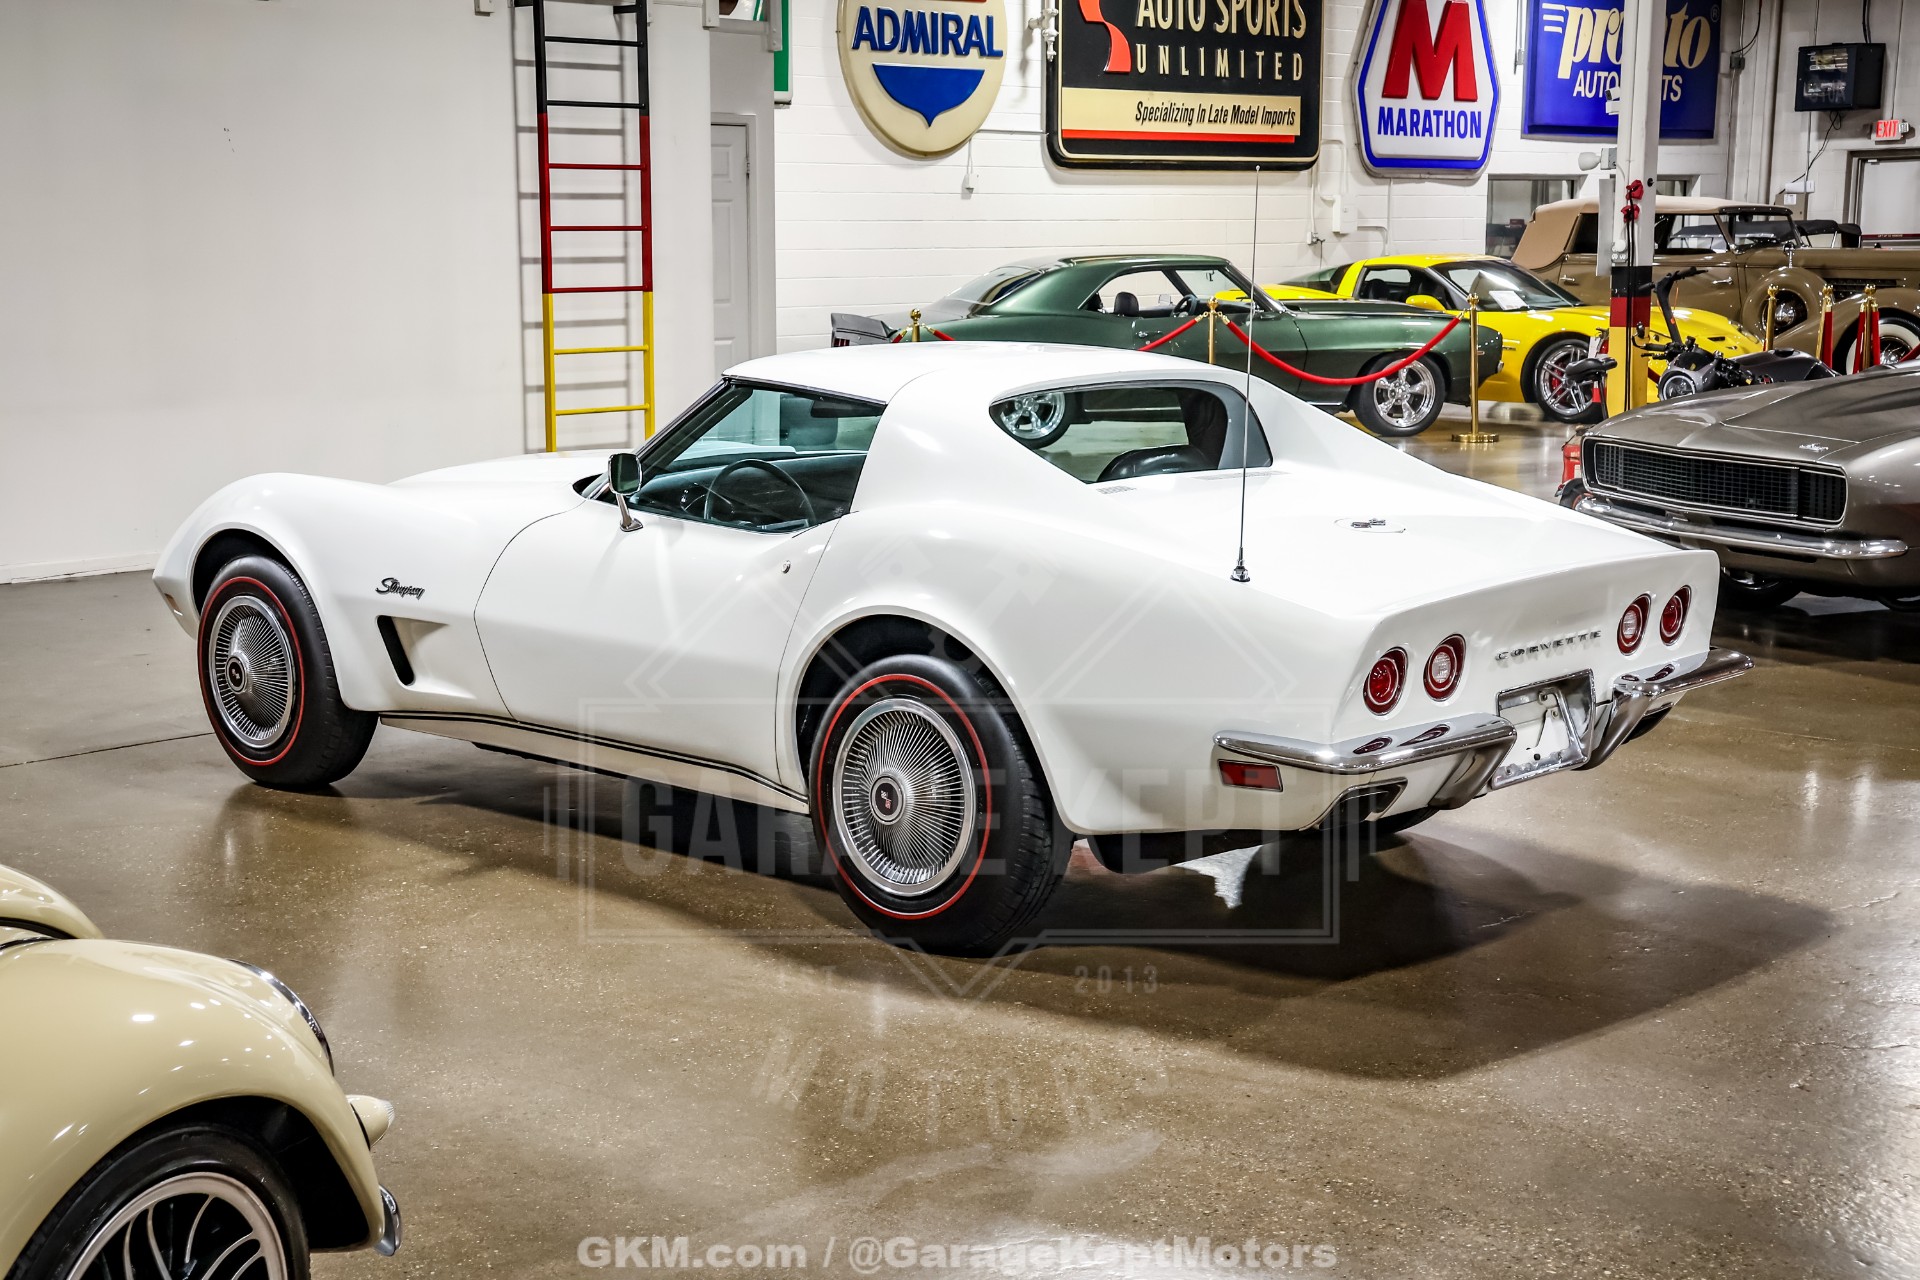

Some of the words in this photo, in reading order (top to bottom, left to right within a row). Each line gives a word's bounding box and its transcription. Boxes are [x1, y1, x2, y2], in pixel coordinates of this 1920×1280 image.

[852, 5, 1003, 57] ADMIRAL
[1136, 43, 1303, 81] UNLIMITED
[1135, 101, 1195, 126] Specializing
[1196, 103, 1207, 124] In
[1208, 104, 1229, 124] Late
[1230, 105, 1260, 125] Model
[1260, 106, 1296, 128] Imports
[1377, 106, 1482, 139] MARATHON
[1876, 120, 1899, 138] EXIT
